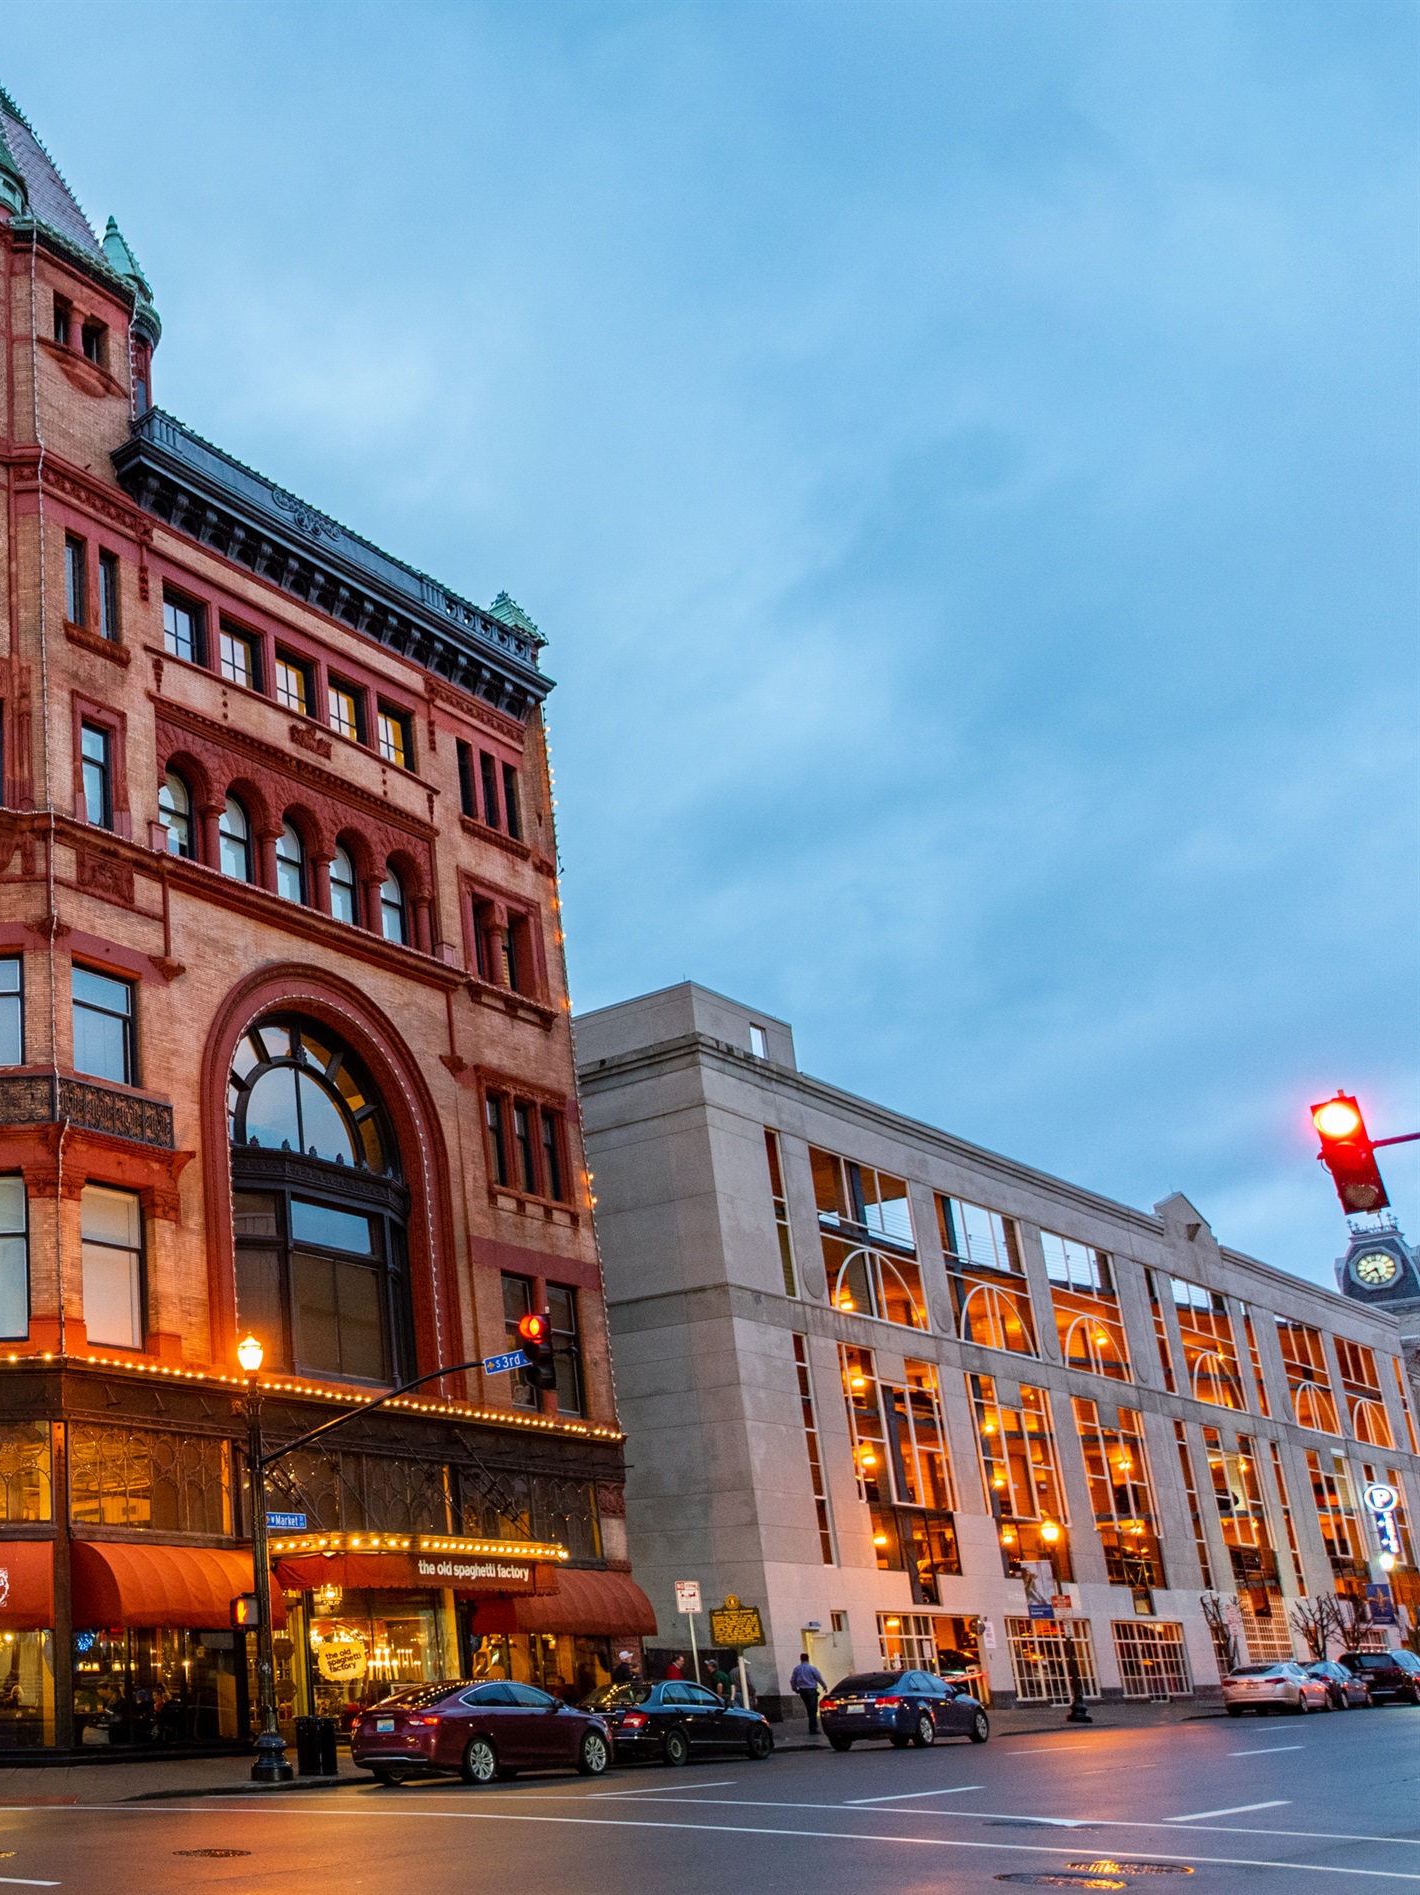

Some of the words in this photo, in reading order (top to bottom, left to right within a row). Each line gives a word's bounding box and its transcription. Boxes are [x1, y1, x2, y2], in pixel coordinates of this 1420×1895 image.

[502, 1353, 521, 1368] 3rd
[275, 1514, 299, 1526] Market
[418, 1560, 435, 1575] the
[437, 1561, 452, 1576] old
[453, 1563, 496, 1580] spaghetti
[497, 1564, 529, 1582] factory
[325, 1652, 338, 1660] the
[340, 1648, 351, 1656] old
[327, 1653, 362, 1666] spaghetti
[329, 1661, 356, 1673] factory
